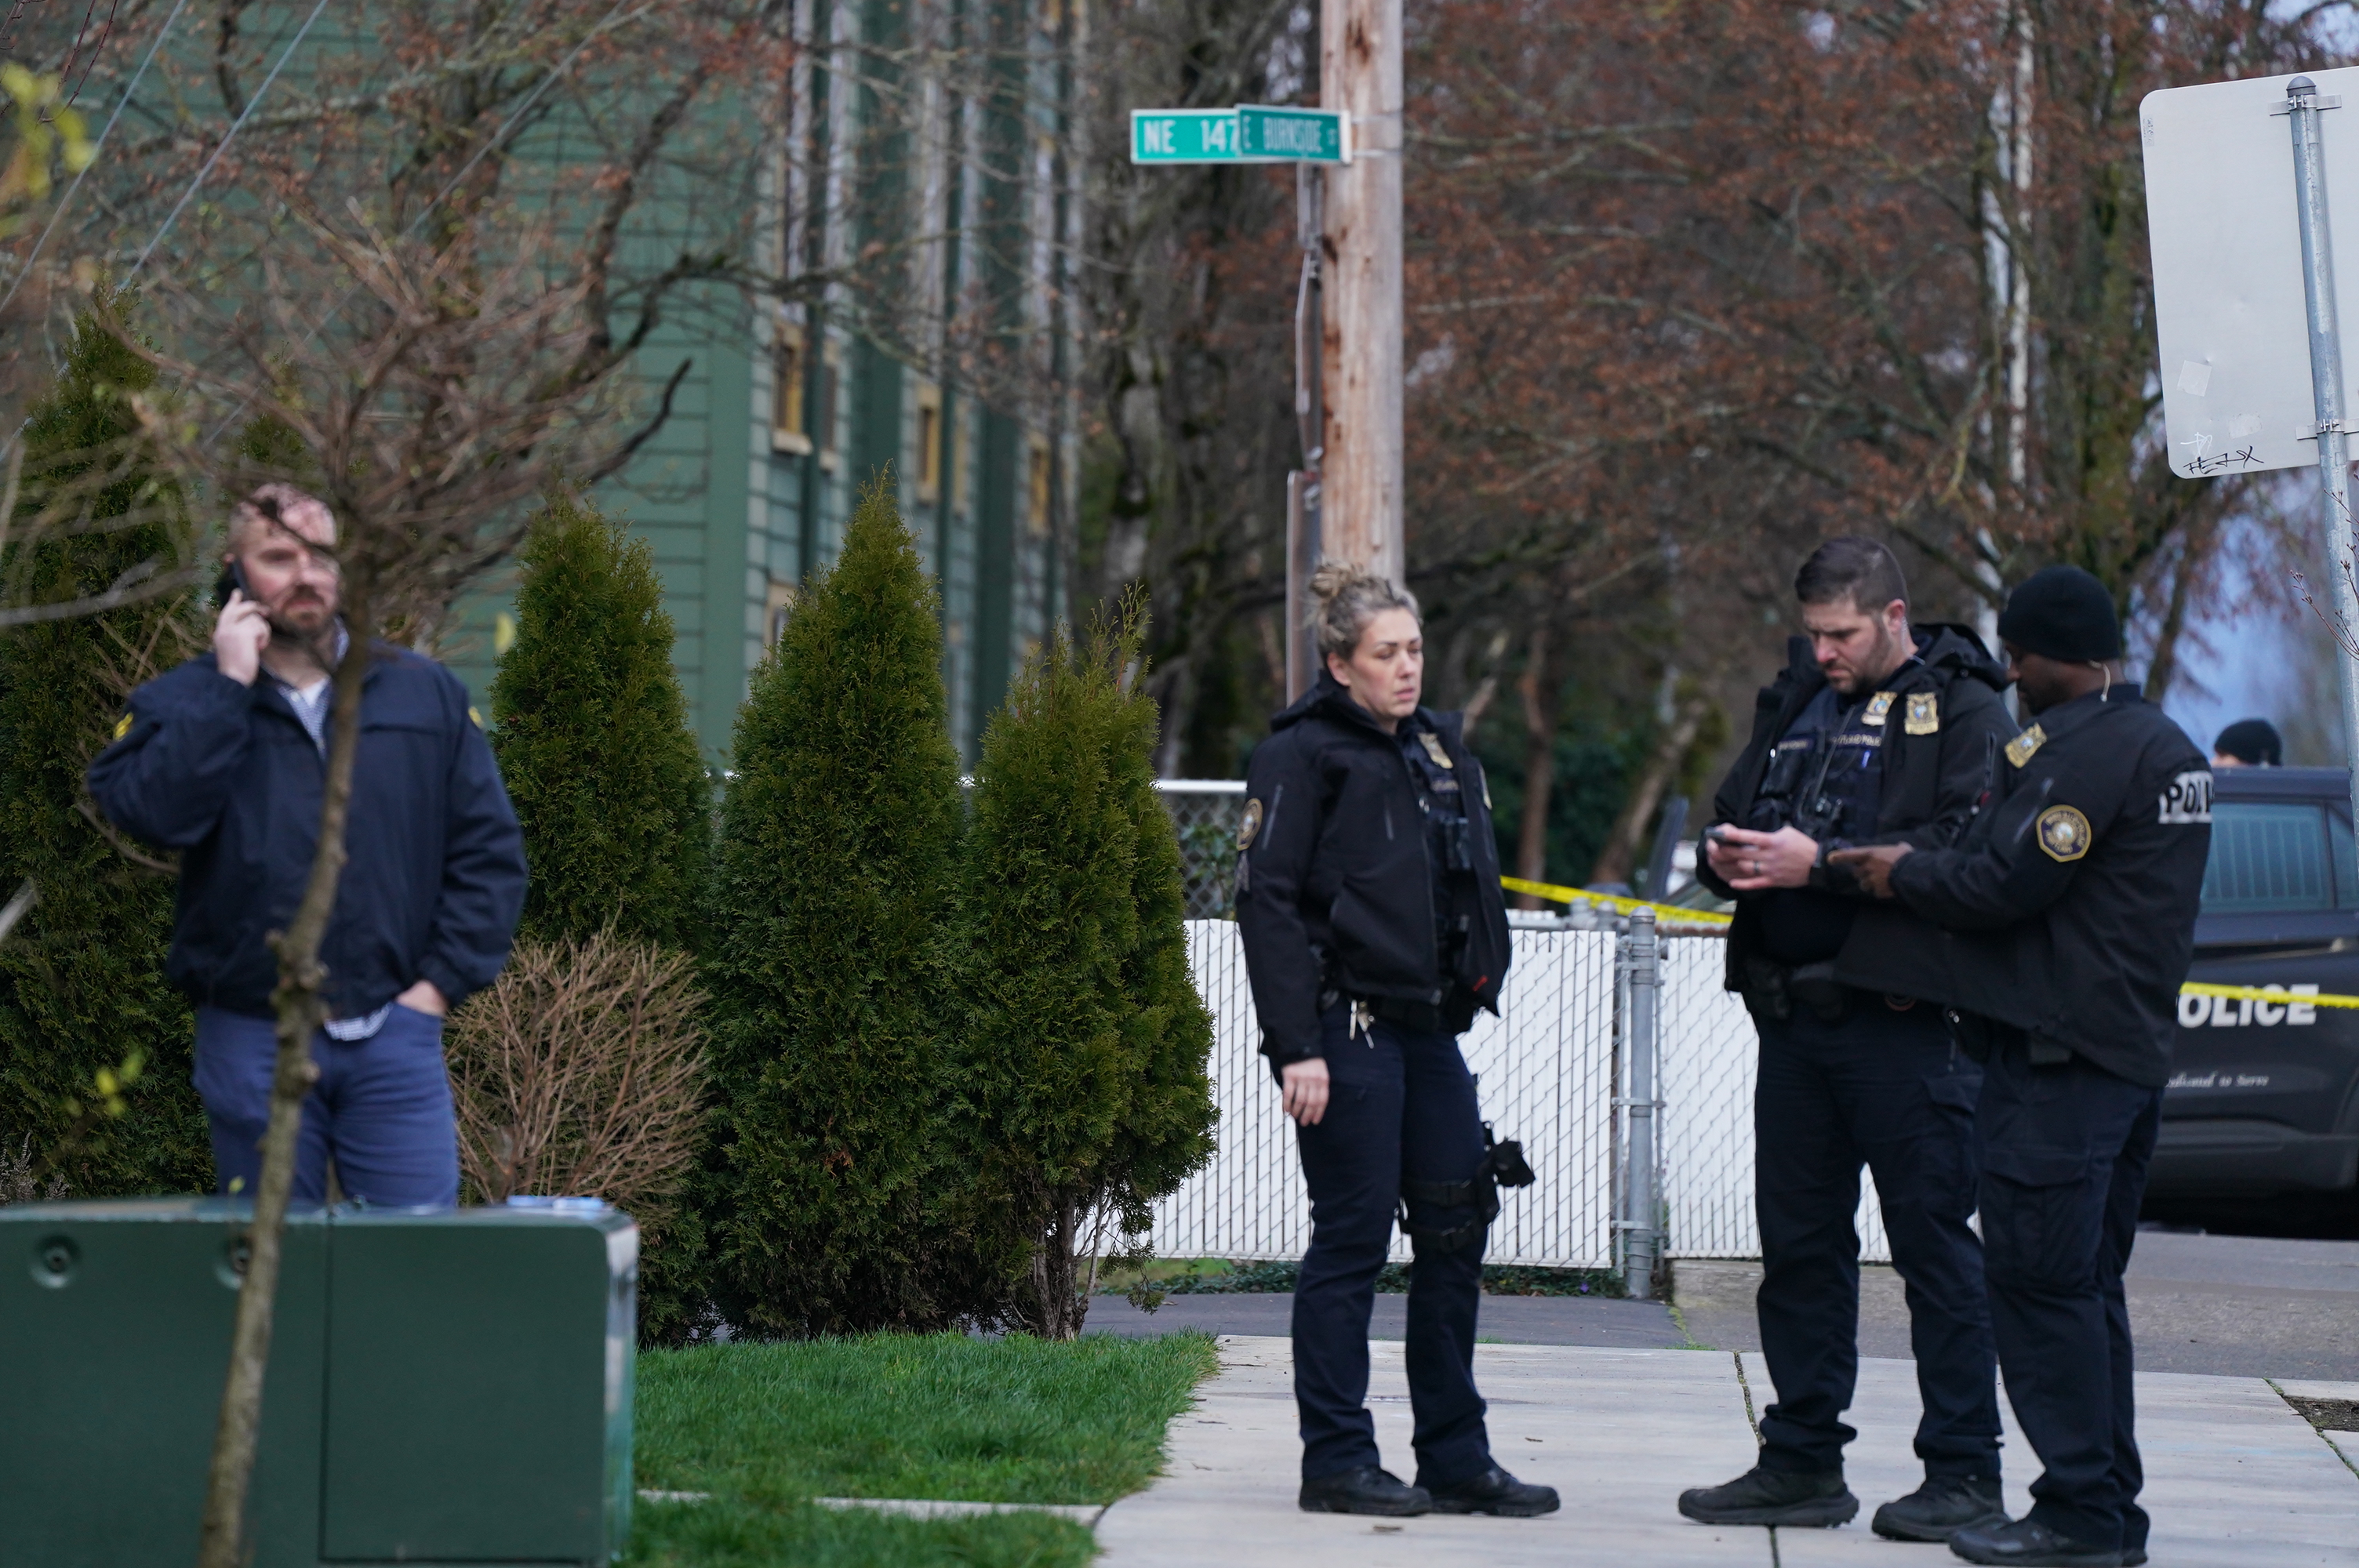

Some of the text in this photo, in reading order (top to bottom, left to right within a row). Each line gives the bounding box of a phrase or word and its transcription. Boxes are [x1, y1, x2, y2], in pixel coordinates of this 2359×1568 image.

[1143, 118, 1239, 153] NE 147
[1242, 115, 1252, 150] E
[1263, 117, 1323, 153] BURNSIDE
[2177, 983, 2320, 1029] OLICE
